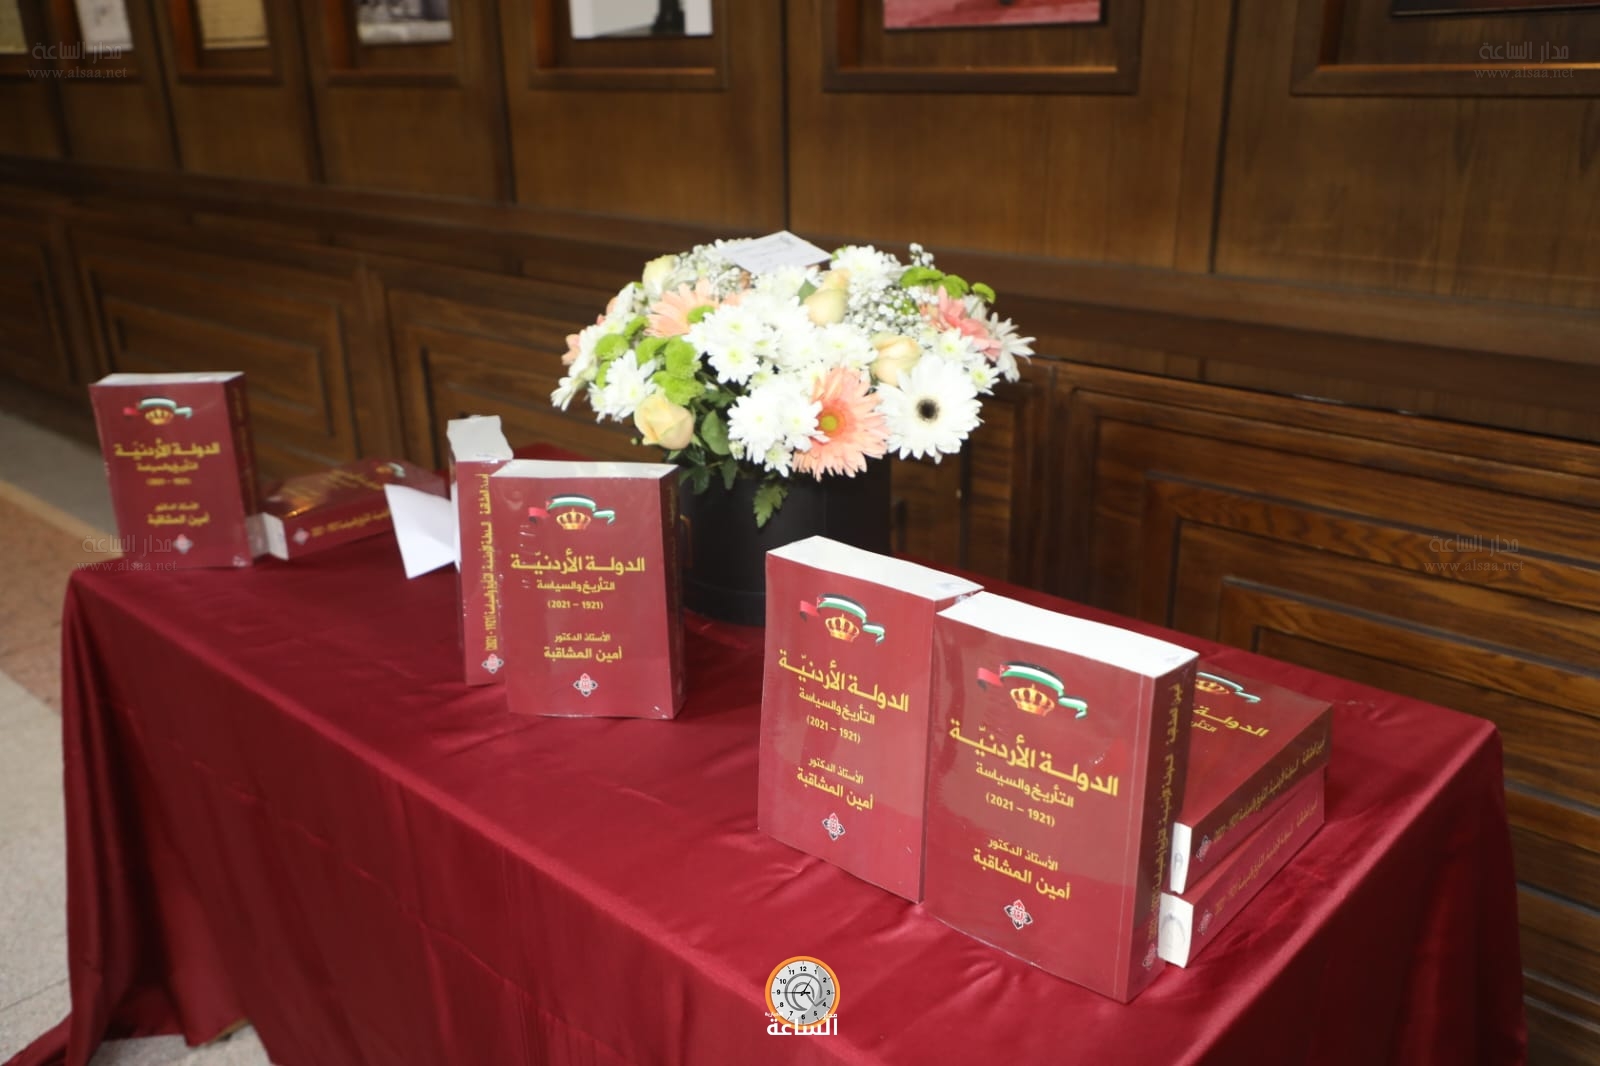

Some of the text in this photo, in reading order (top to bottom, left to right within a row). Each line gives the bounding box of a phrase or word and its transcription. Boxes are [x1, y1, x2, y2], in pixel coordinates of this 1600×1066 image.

[585, 555, 645, 576] الدولة
[543, 645, 622, 663] أمين المشاقبة
[847, 674, 909, 712] الدولة
[1192, 705, 1269, 736] الدولة
[808, 757, 864, 784] الأستاذ الدكتور
[1038, 750, 1119, 796] الدولة
[797, 767, 873, 811] أمين المشاقبة
[988, 838, 1058, 871] الأستاذ الدكتور
[973, 847, 1071, 901] أمين المشاقبة
